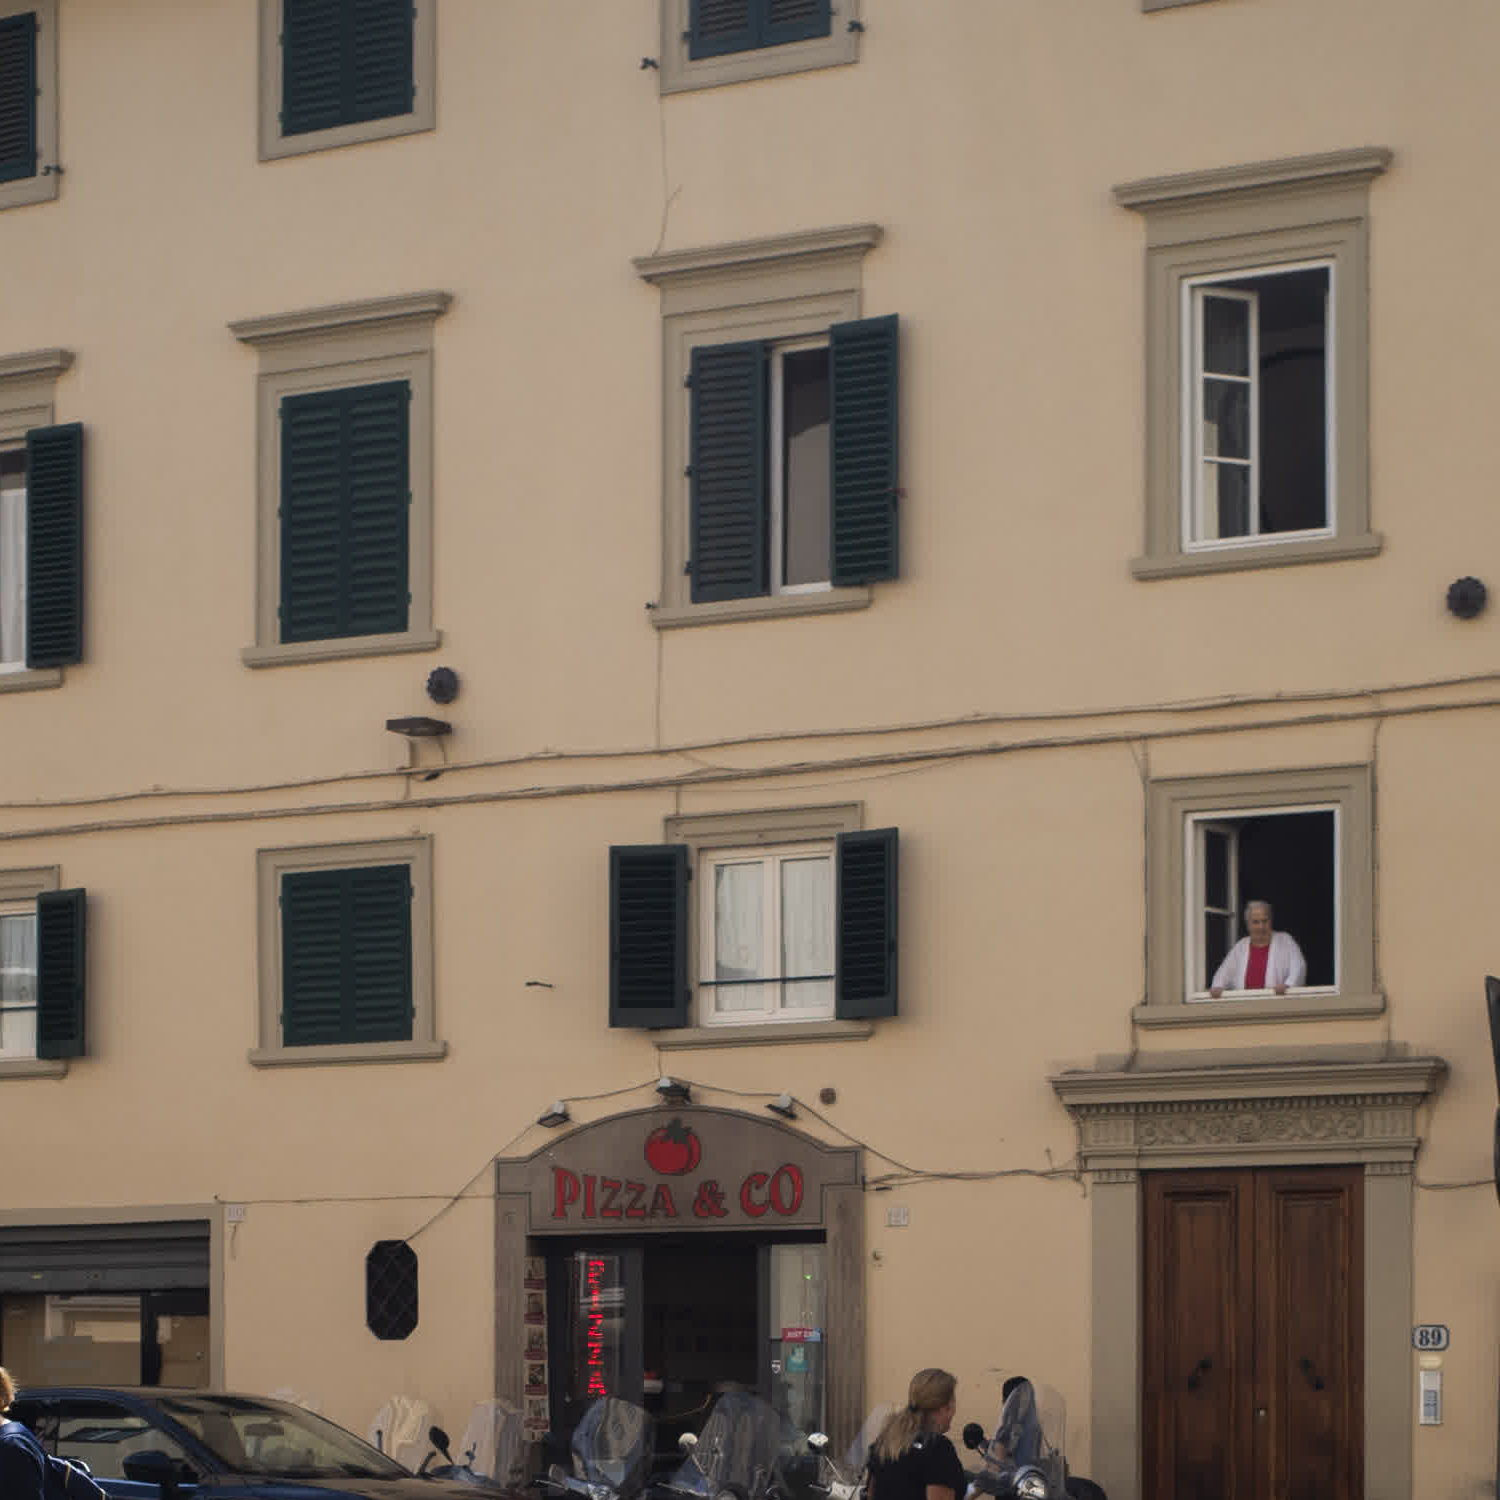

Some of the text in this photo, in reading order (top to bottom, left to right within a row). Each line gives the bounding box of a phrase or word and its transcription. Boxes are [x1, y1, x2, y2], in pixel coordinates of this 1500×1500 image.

[551, 1163, 804, 1219] PIZZA & CO
[1419, 1328, 1442, 1346] 89
